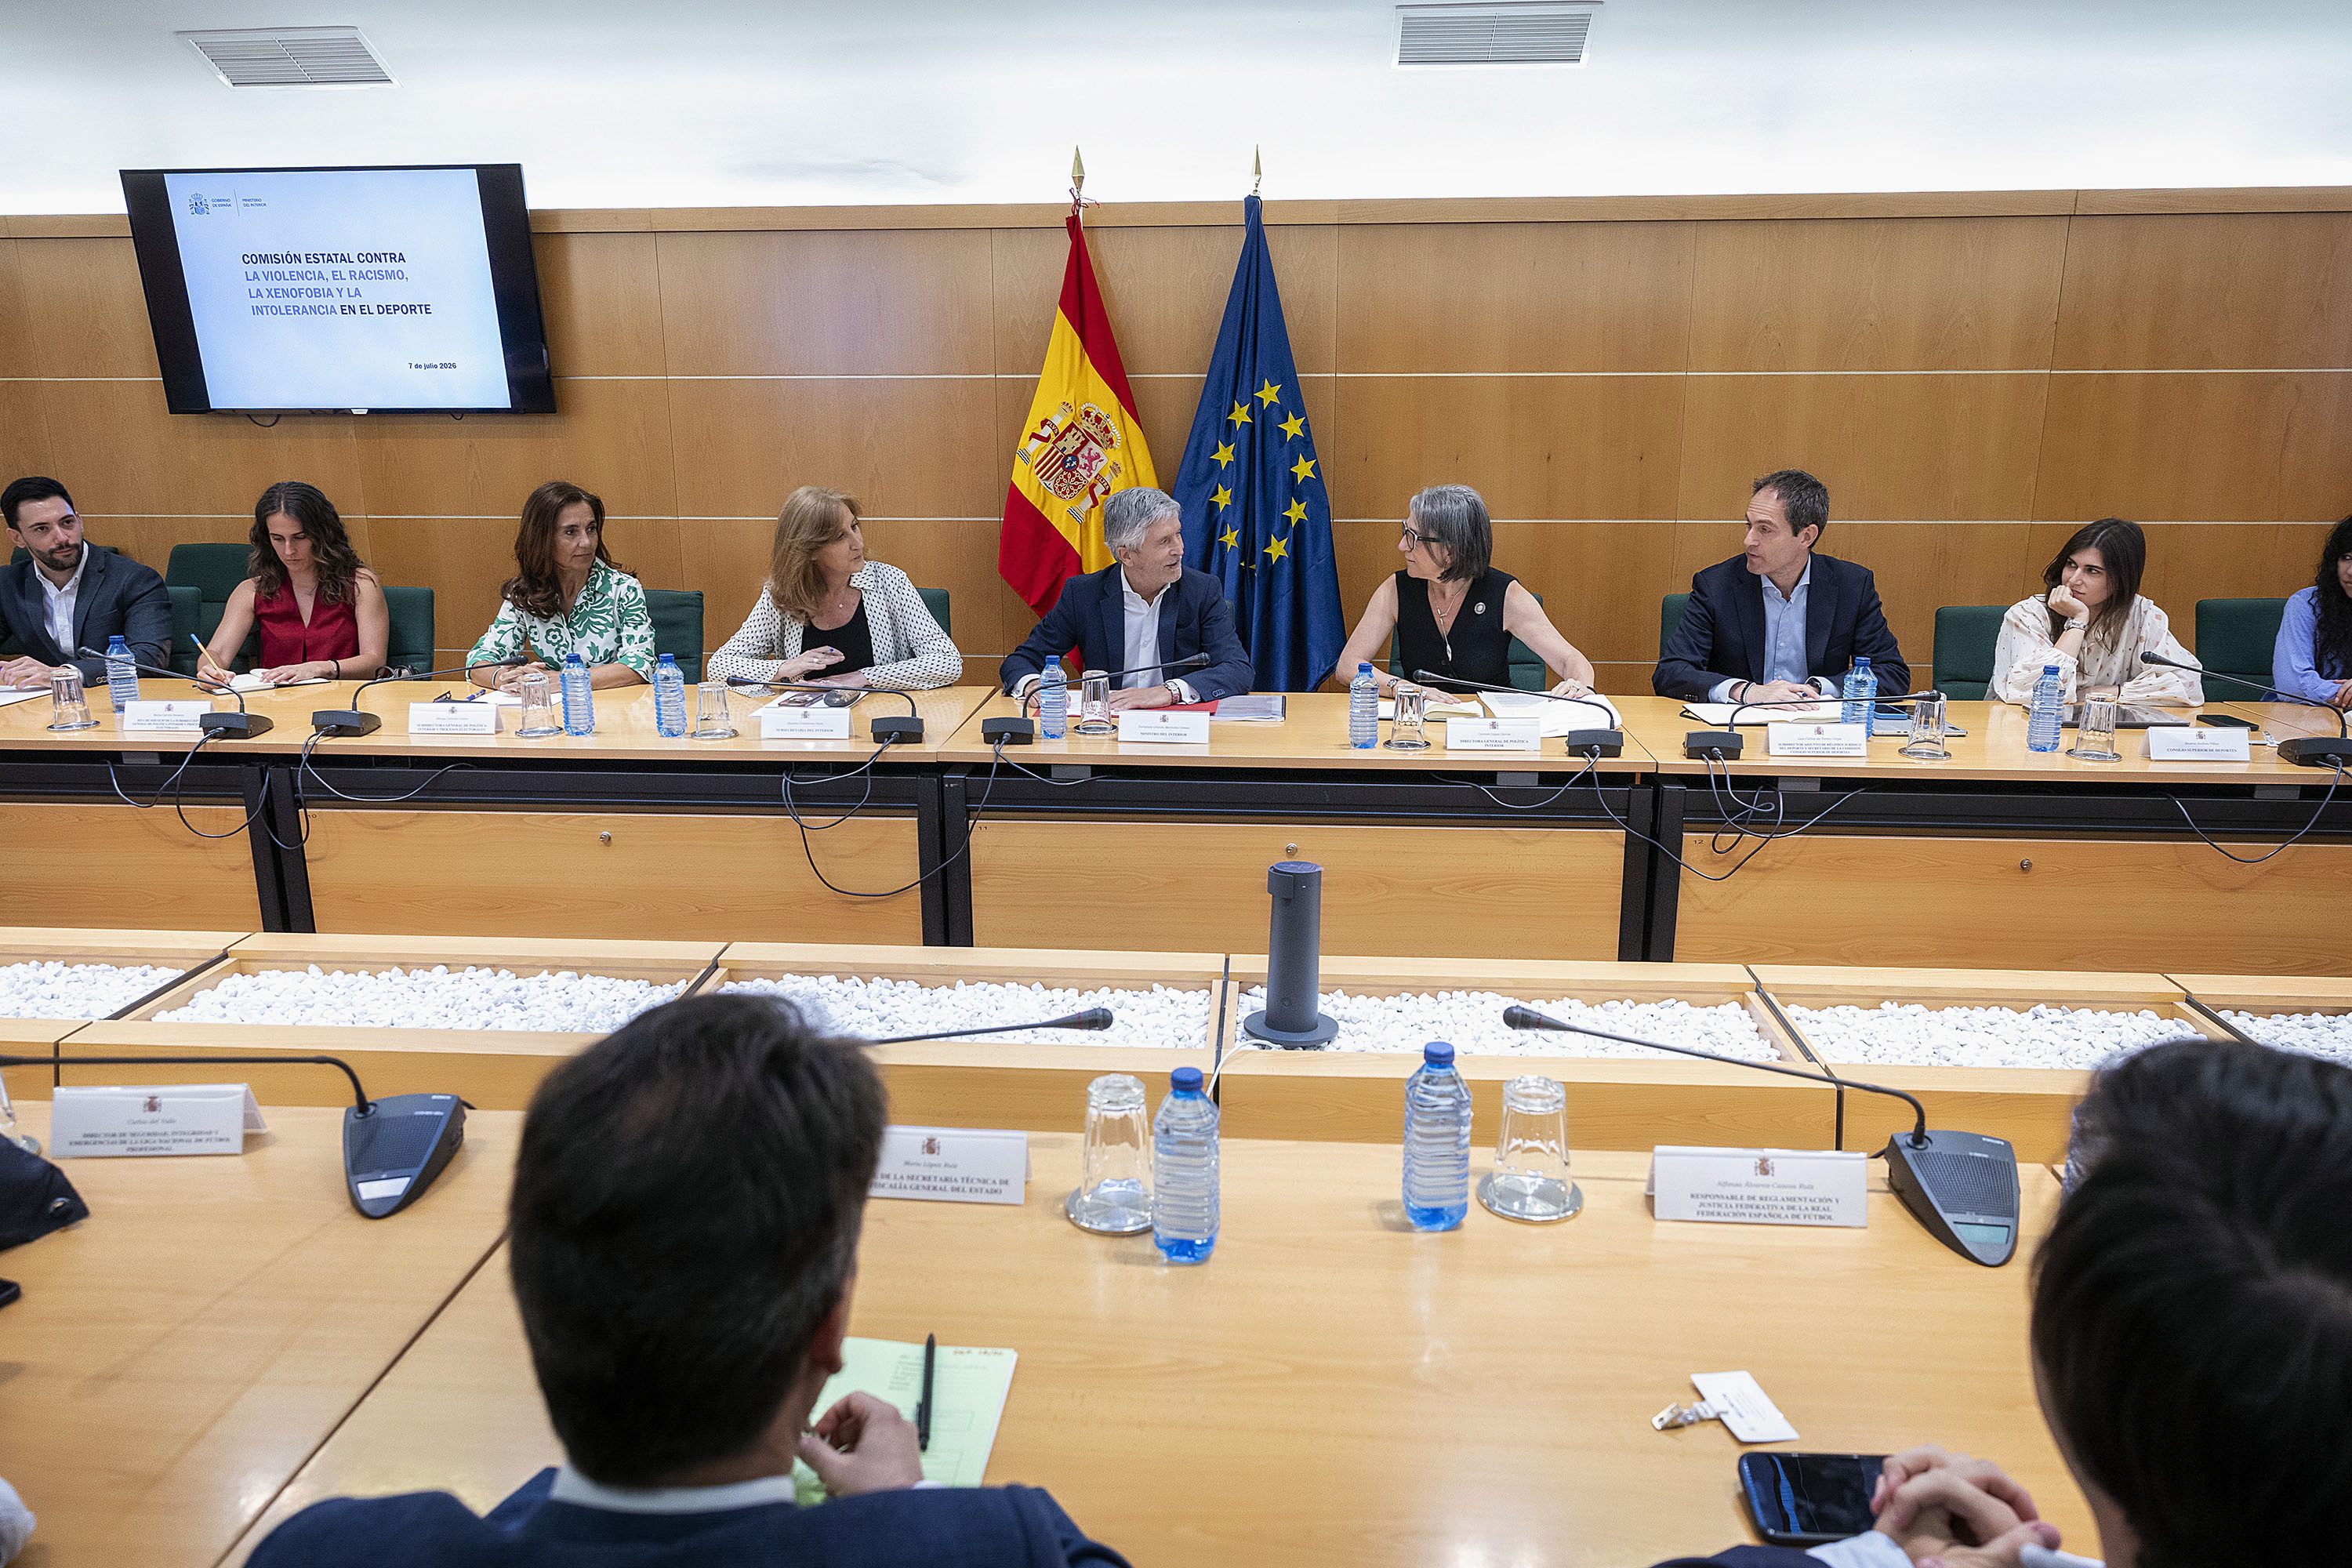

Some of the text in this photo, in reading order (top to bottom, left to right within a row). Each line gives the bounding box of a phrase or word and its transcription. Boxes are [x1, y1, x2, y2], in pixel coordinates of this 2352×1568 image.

[241, 251, 406, 265] COMISIÓN ESTATAL CONTRA
[245, 270, 408, 282] LA VIOLENCIA, EL RACISMO,
[249, 288, 362, 299] LA XENOFOBIA Y LA
[252, 304, 432, 316] INTOLERANCIA EN EL DEPORTE
[1047, 420, 1058, 434] PLVS
[1097, 474, 1109, 490] VLTRA
